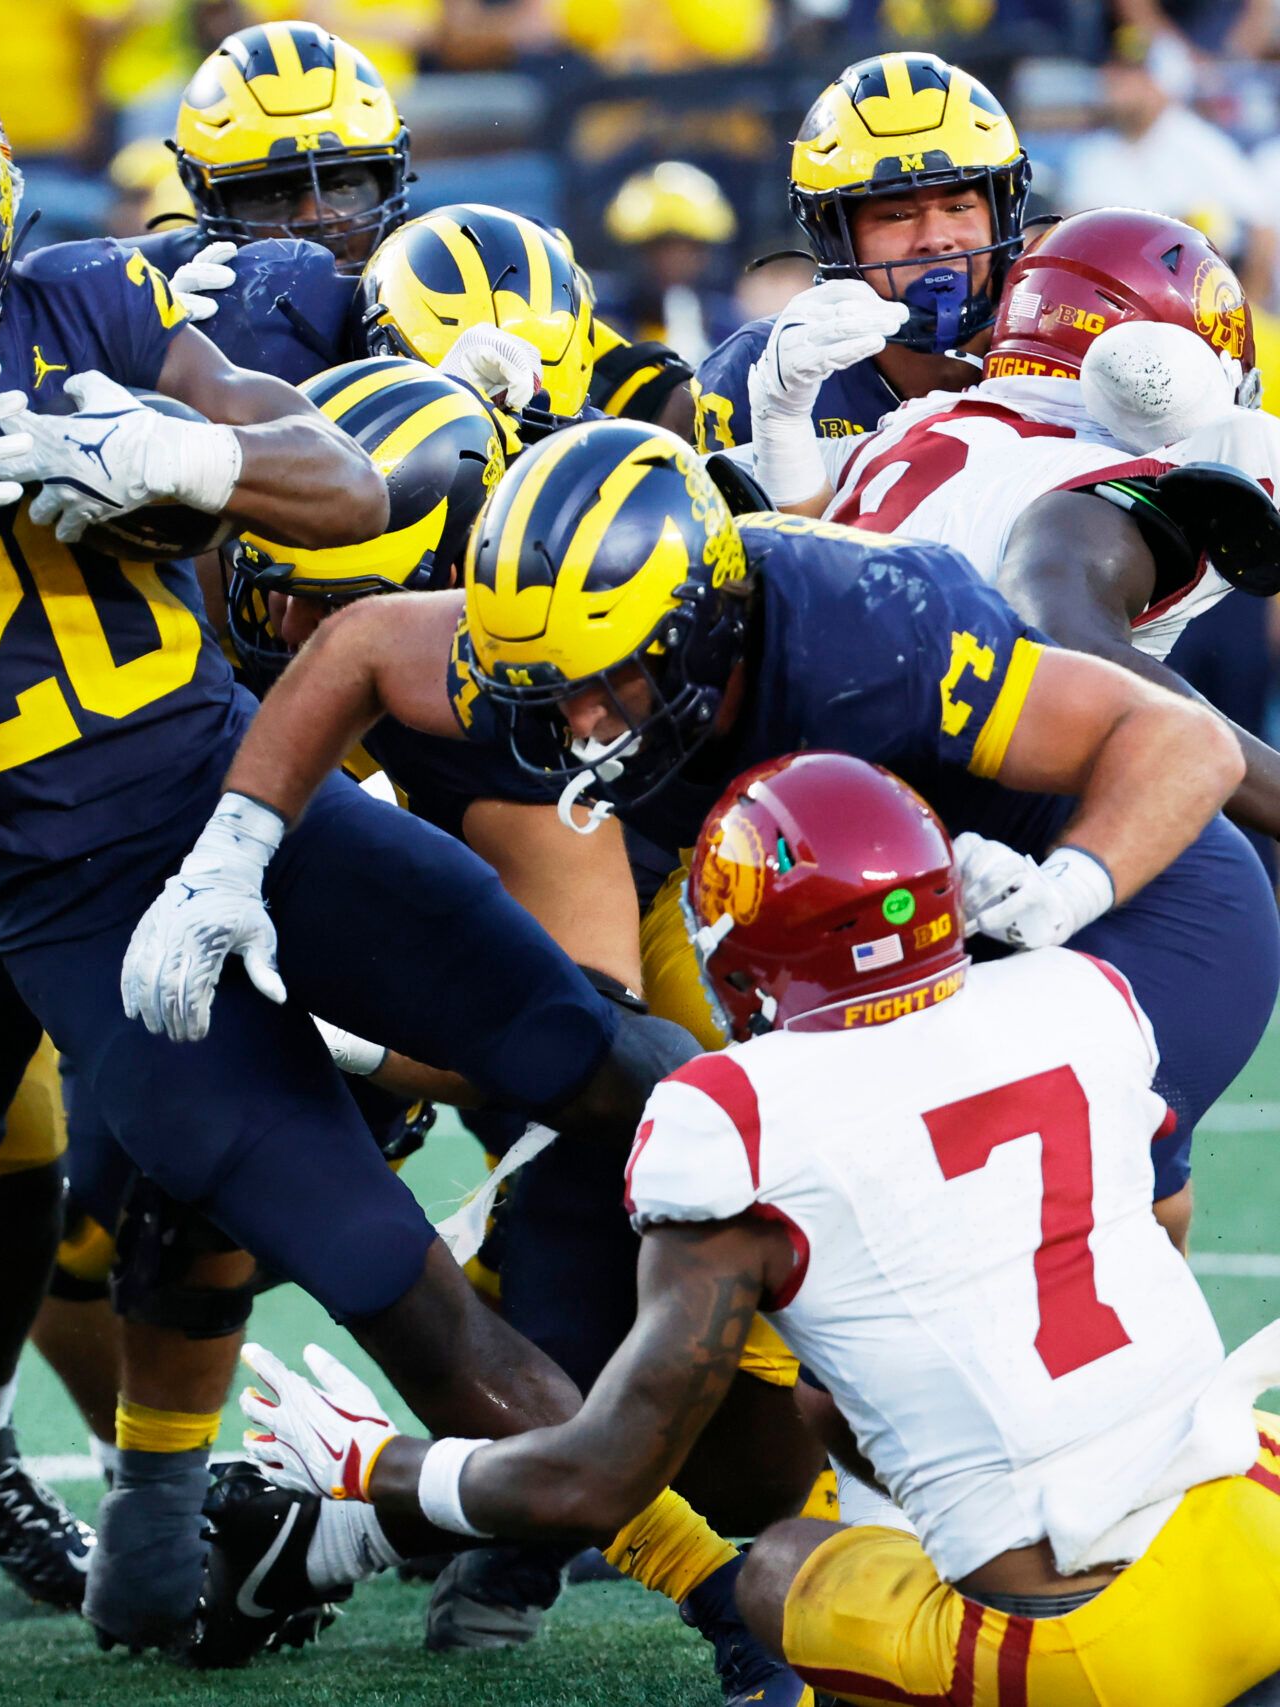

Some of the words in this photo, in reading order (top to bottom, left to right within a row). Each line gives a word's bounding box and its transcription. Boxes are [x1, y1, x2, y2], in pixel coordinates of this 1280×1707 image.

[899, 152, 925, 173] M
[925, 273, 954, 285] SHOCK
[843, 987, 930, 1029] FIGHT
[920, 1063, 1133, 1380] 7
